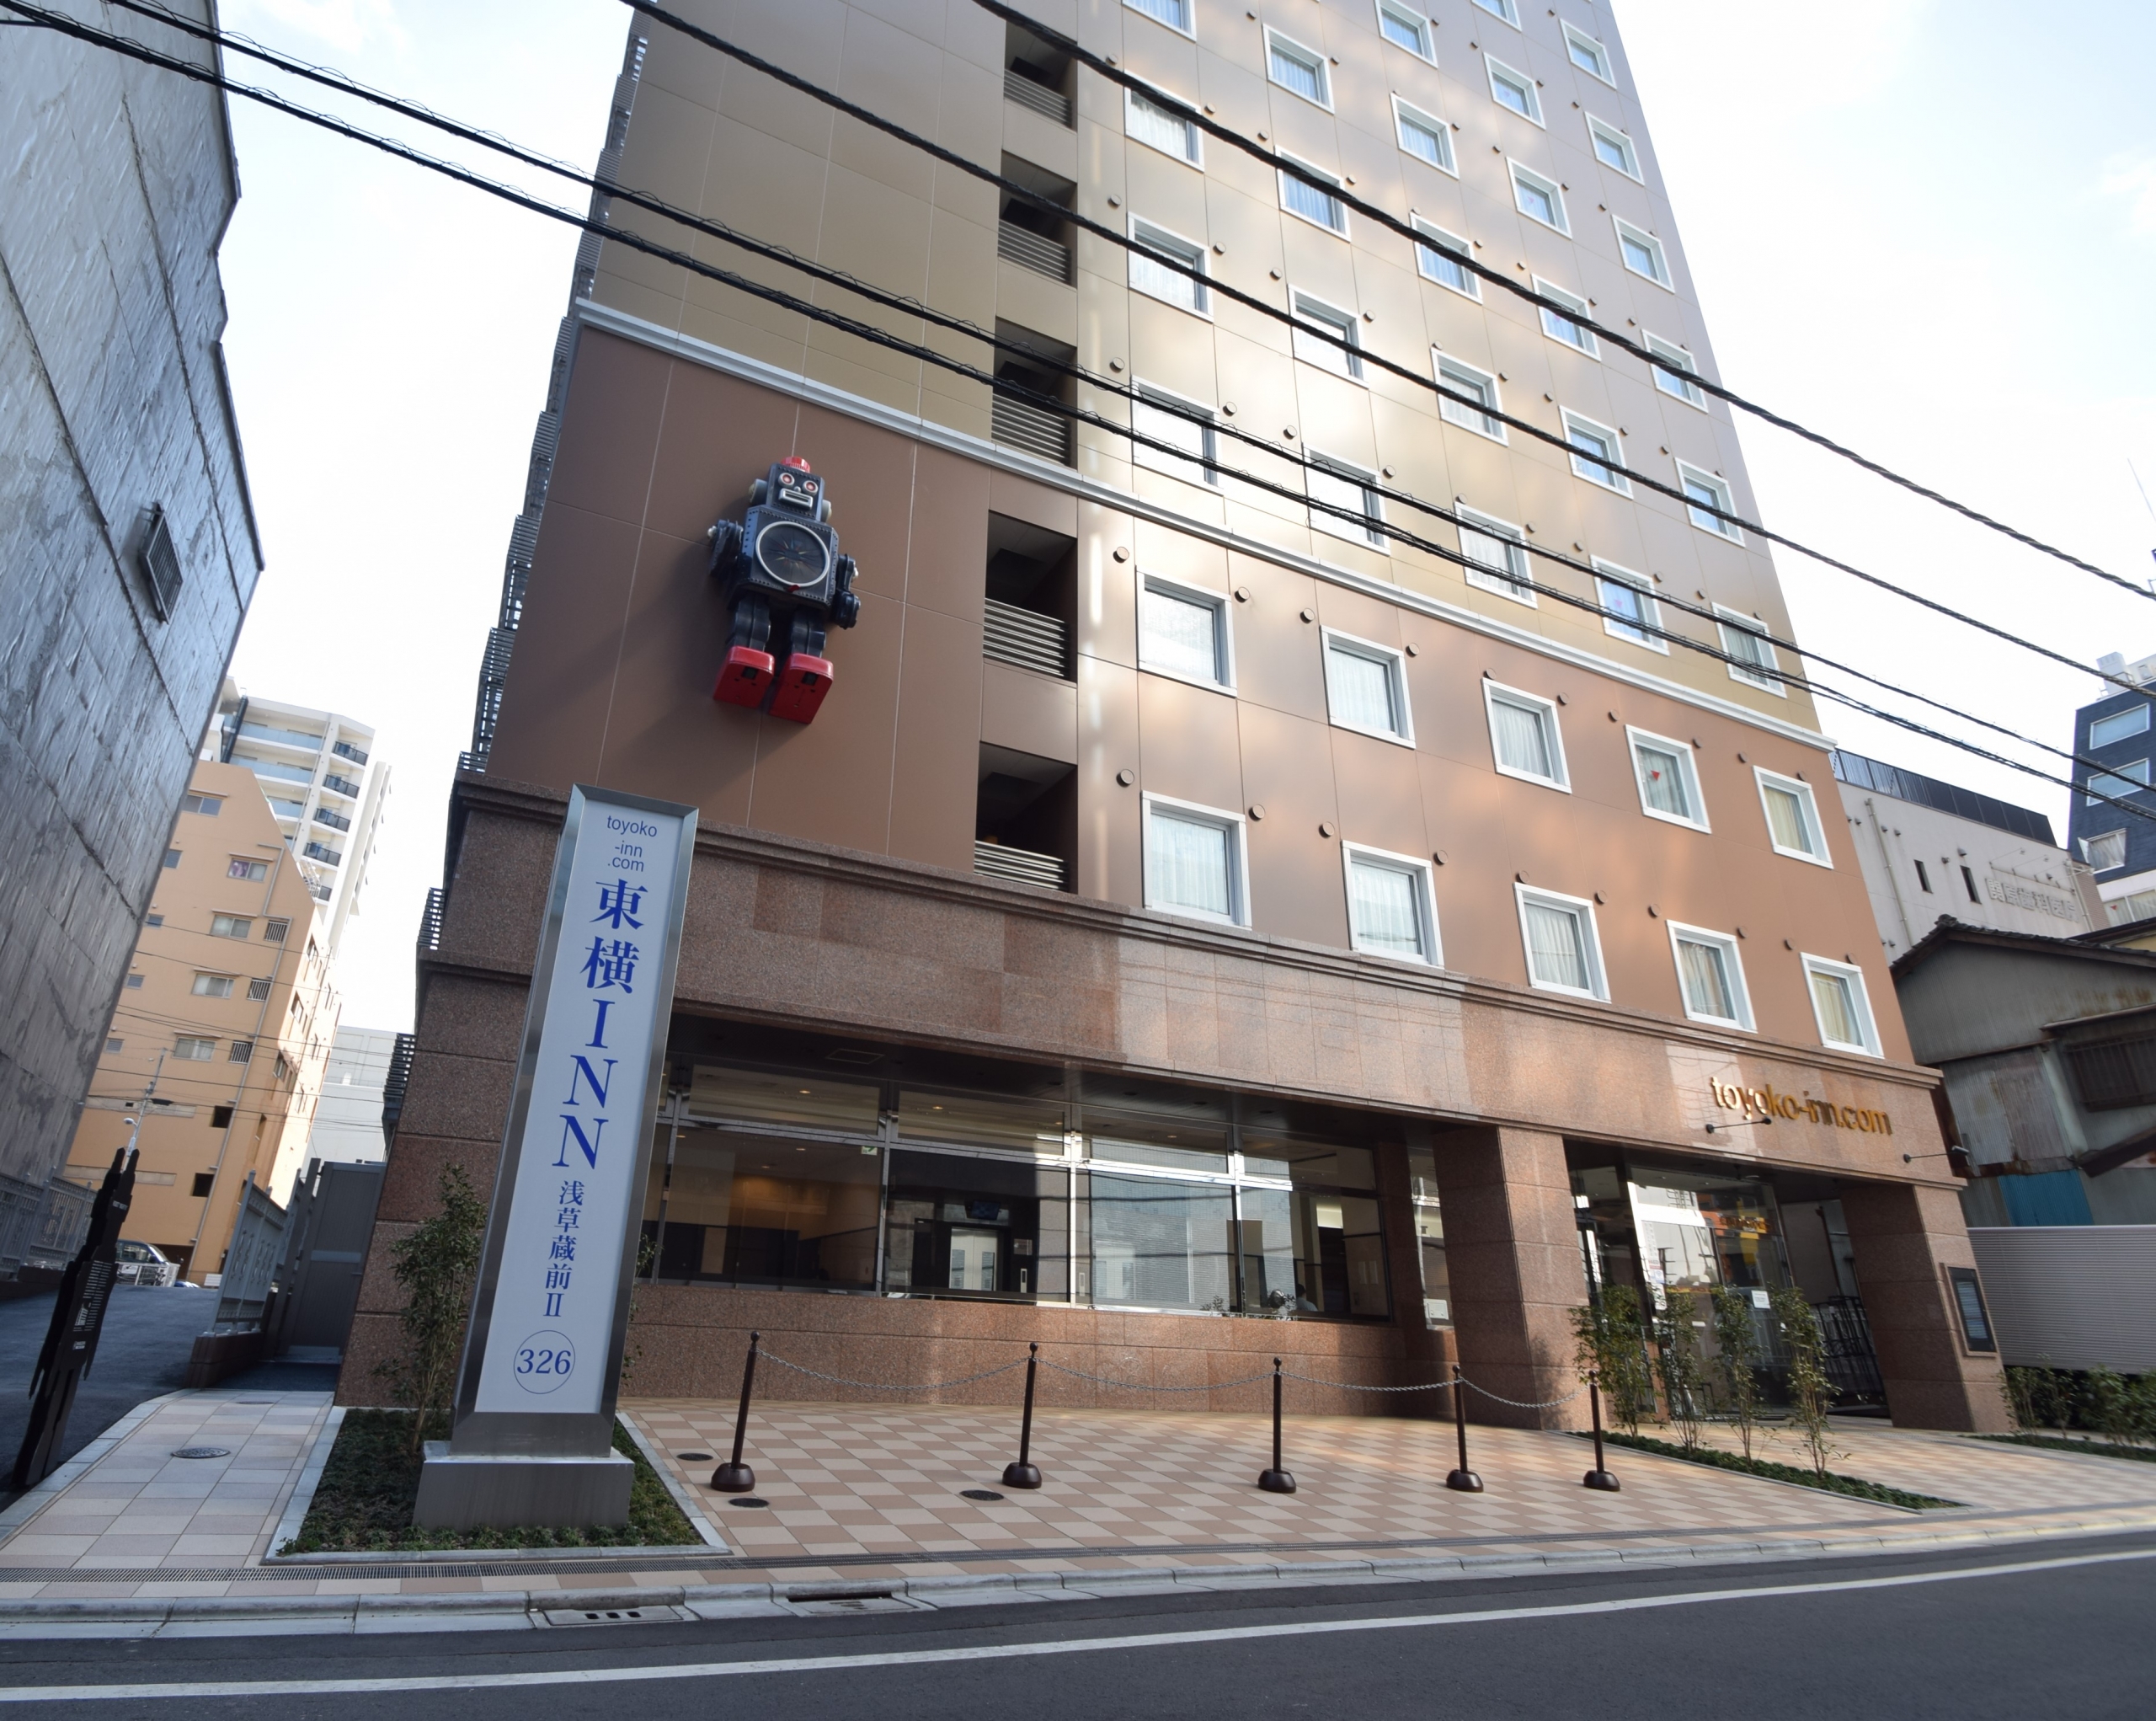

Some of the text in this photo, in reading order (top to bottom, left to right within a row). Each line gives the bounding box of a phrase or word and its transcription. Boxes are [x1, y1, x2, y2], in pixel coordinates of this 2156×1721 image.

[607, 815, 658, 837] toyoko
[615, 840, 643, 858] -inn
[607, 857, 644, 873] .com
[1711, 1077, 1892, 1136] toyoko-inn.com
[516, 1349, 572, 1375] 326
